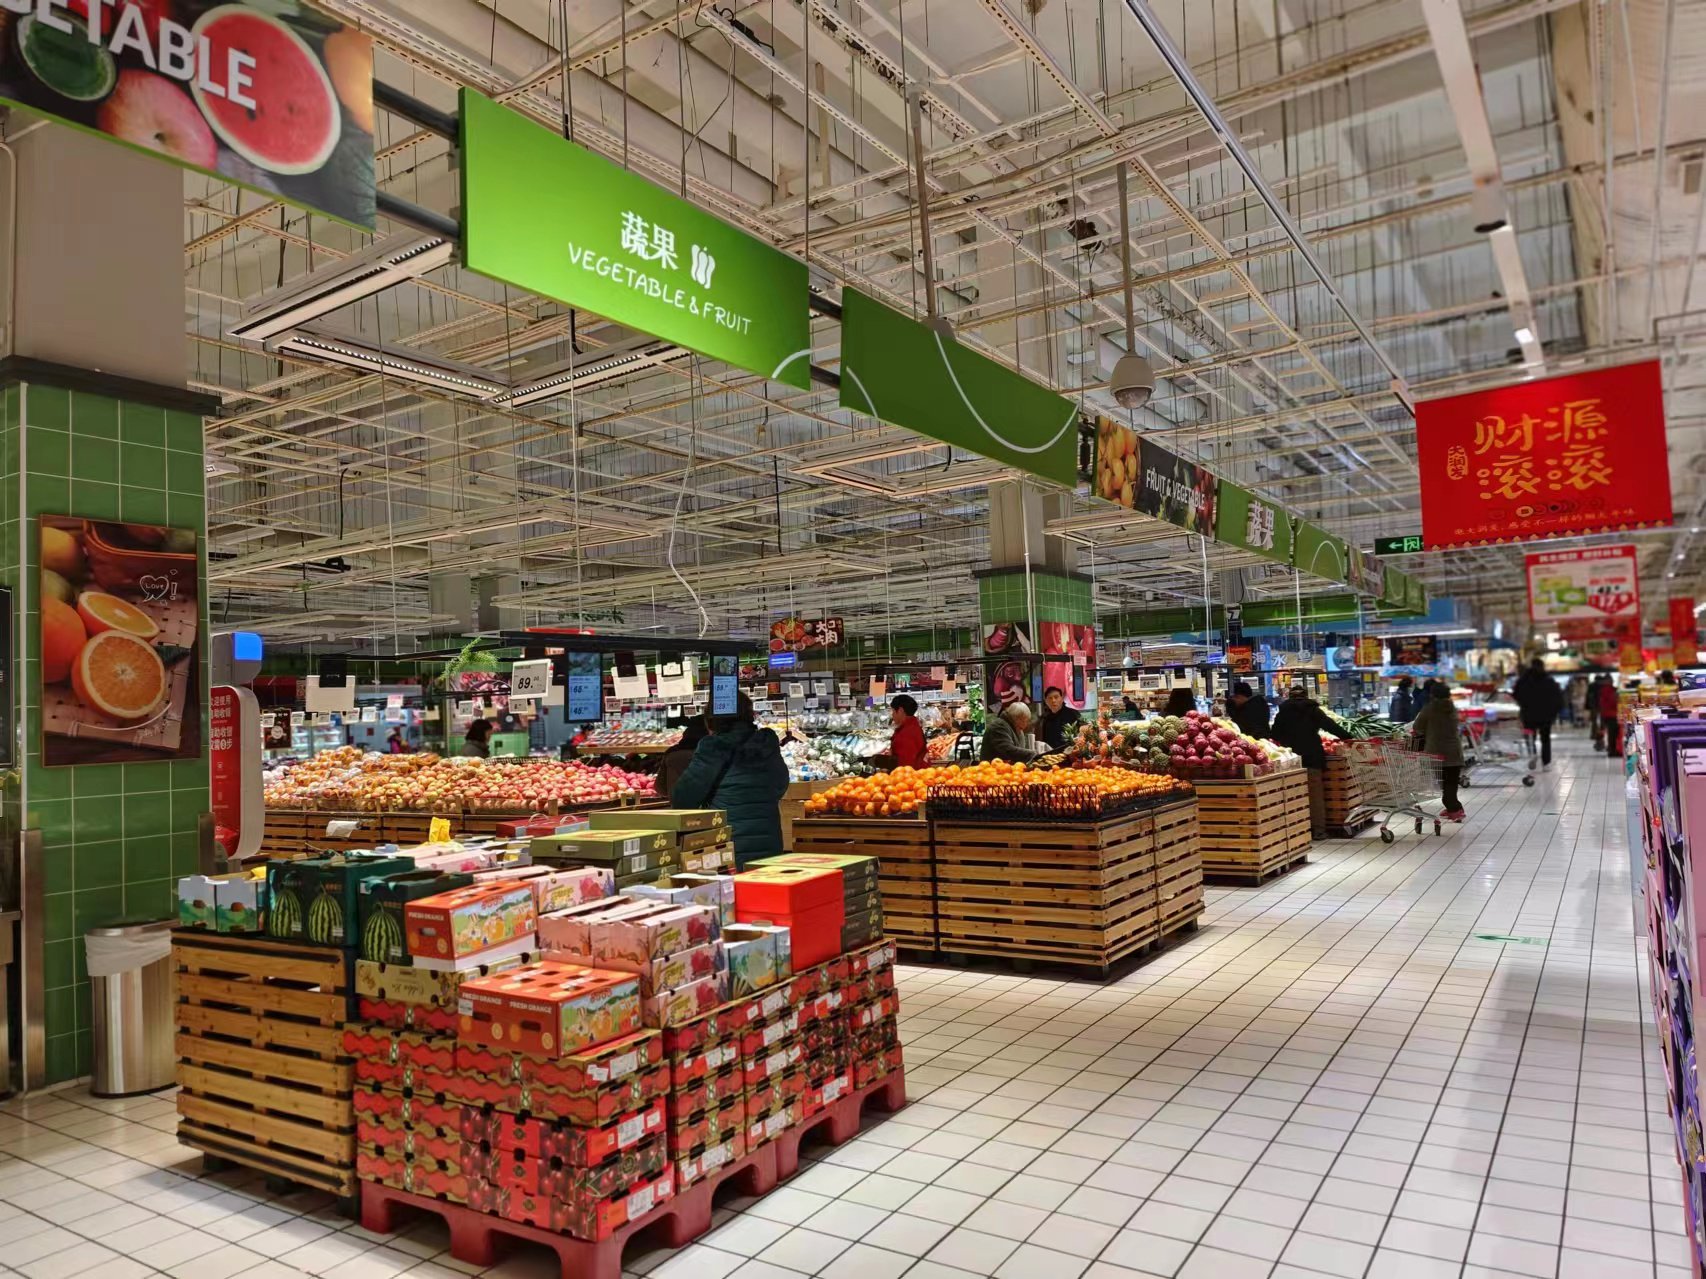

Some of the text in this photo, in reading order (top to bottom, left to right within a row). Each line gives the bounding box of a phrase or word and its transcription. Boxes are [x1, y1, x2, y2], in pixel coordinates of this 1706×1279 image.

[0, 0, 257, 110] ETABLE
[620, 210, 679, 270] 蔬果
[568, 241, 752, 335] VEGETABLE & FRUIT
[1146, 467, 1166, 493] FRUIT
[1172, 480, 1205, 511] VEGETABLE
[1246, 500, 1275, 550] 蔬果
[509, 1001, 552, 1014] FRESH ORANGE
